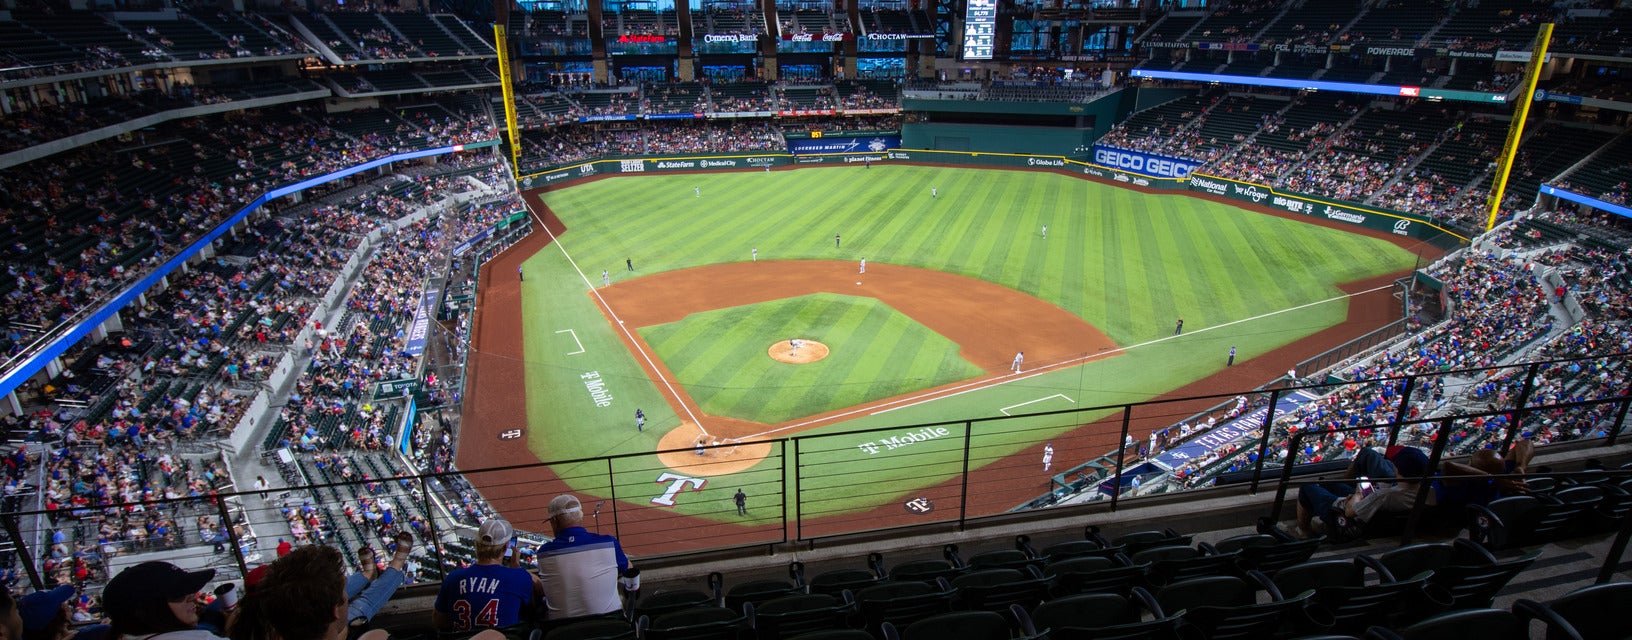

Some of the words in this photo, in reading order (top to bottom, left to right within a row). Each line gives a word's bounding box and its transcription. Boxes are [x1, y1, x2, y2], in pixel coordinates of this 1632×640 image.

[1367, 47, 1415, 56] POWERADE
[621, 164, 645, 172] SELTZER
[1095, 149, 1144, 171] GEICO
[1198, 179, 1228, 192] National
[1244, 186, 1268, 202] Kroger
[1273, 197, 1287, 206] BIG
[584, 378, 614, 407] Mobile
[879, 427, 950, 451] Mobile
[1194, 426, 1240, 449] TEXAS
[459, 577, 500, 595] RYAN
[453, 598, 500, 633] 34
